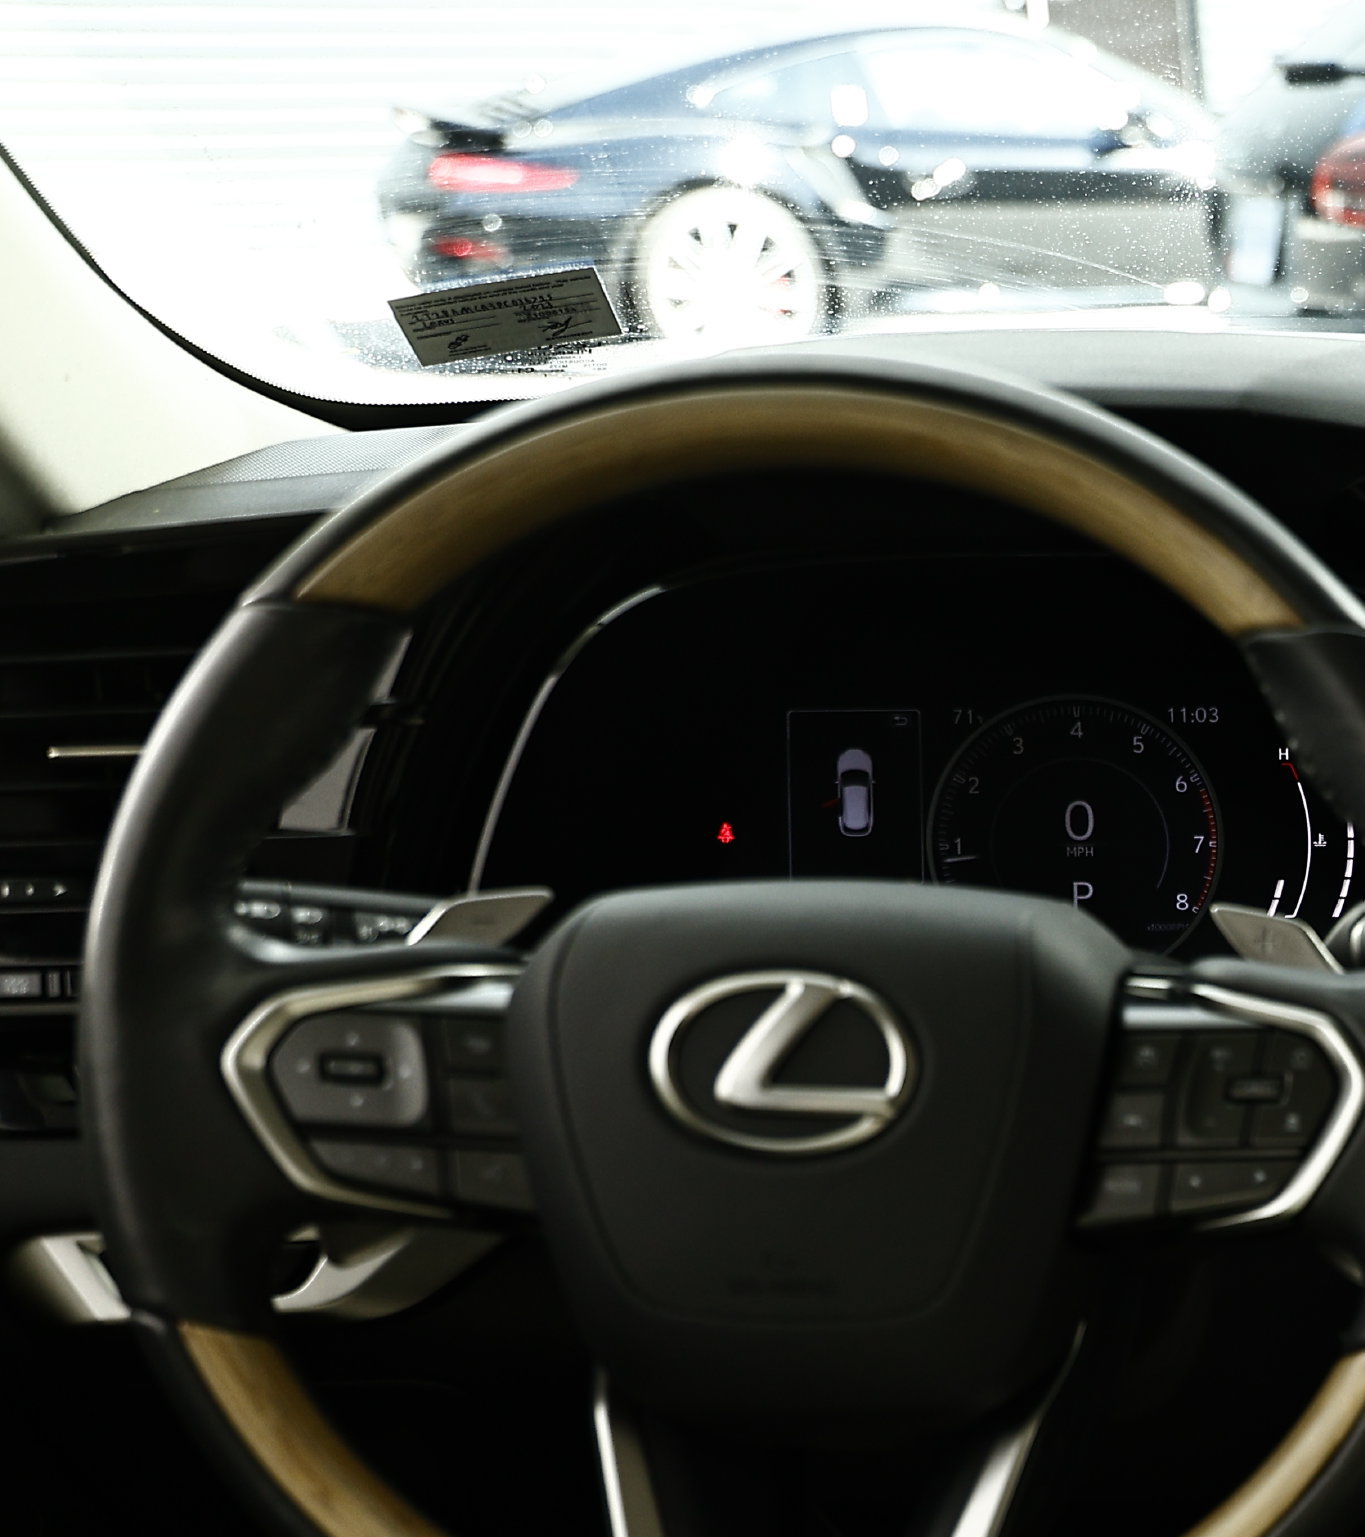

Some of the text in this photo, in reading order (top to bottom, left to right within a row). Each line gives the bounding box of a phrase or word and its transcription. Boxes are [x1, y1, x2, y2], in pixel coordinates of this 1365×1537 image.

[1167, 706, 1221, 725] 11:03
[1069, 722, 1084, 739] 4
[1012, 737, 1025, 755] 3
[1131, 736, 1145, 755] 5
[1278, 746, 1290, 761] H
[967, 777, 981, 796] 2
[1175, 776, 1188, 793] 6
[1063, 799, 1096, 843] 0
[954, 838, 963, 855] 1
[1066, 846, 1094, 858] MPH
[1193, 836, 1205, 854] 7
[1072, 881, 1095, 908] P
[1175, 893, 1189, 912] 8
